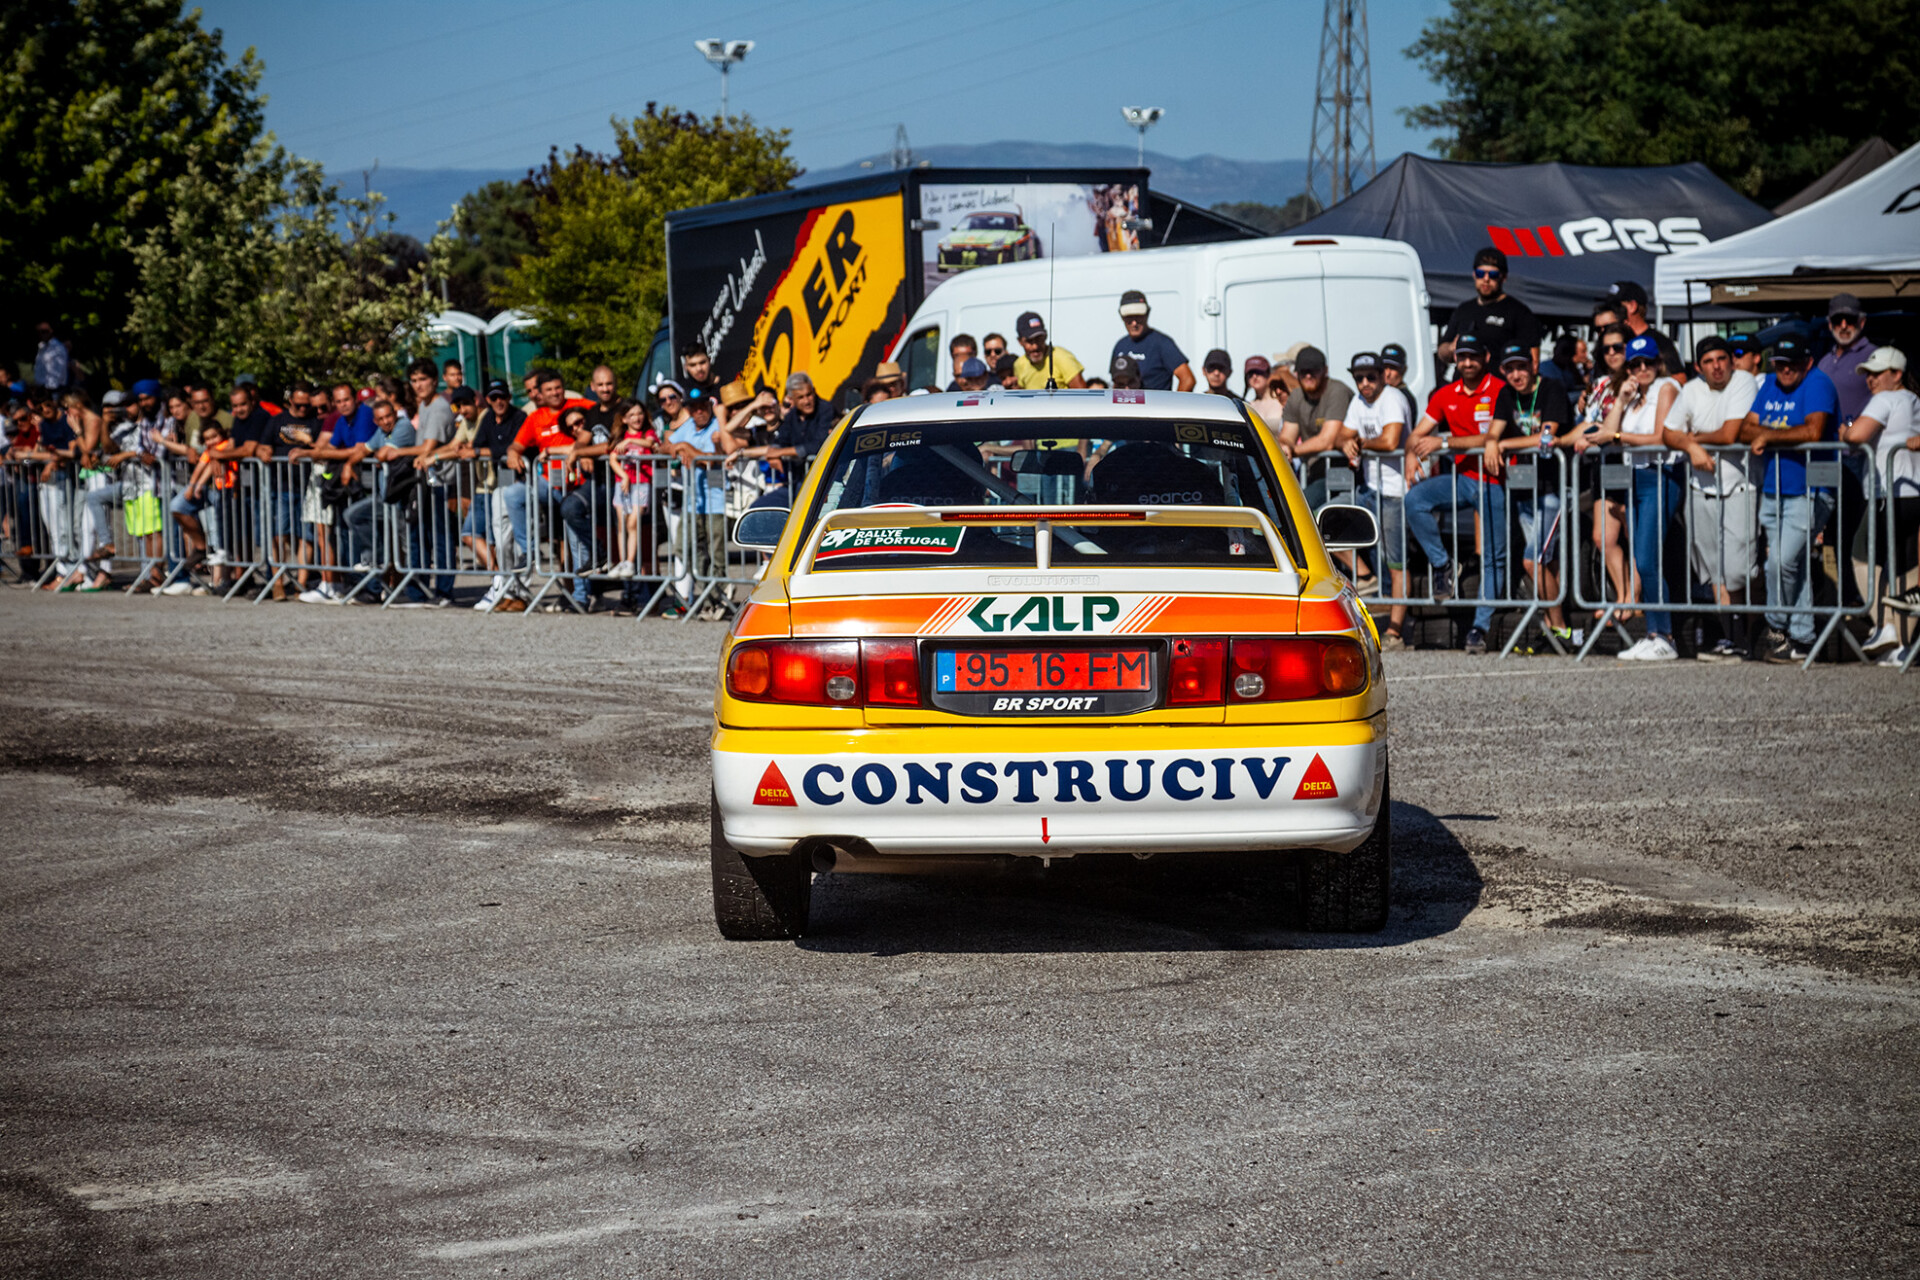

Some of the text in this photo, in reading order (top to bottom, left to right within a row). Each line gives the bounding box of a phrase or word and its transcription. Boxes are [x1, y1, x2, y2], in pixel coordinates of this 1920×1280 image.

[1559, 216, 1711, 256] RRS
[817, 253, 869, 365] SPORT
[889, 431, 922, 442] ESC
[1211, 430, 1243, 442] ESC
[888, 439, 922, 448] ONLINE
[1212, 438, 1245, 449] ONLINE
[856, 528, 904, 538] RALLYE
[853, 536, 871, 547] DE
[874, 536, 948, 546] PORTUGAL
[991, 575, 1080, 587] EVOLUTION
[967, 595, 1120, 633] GALP
[941, 674, 950, 685] P
[992, 697, 1099, 711] BR SPORT
[802, 756, 1292, 806] CONSTRUCIV
[1303, 781, 1332, 791] DELTA
[760, 788, 790, 798] DELTA
